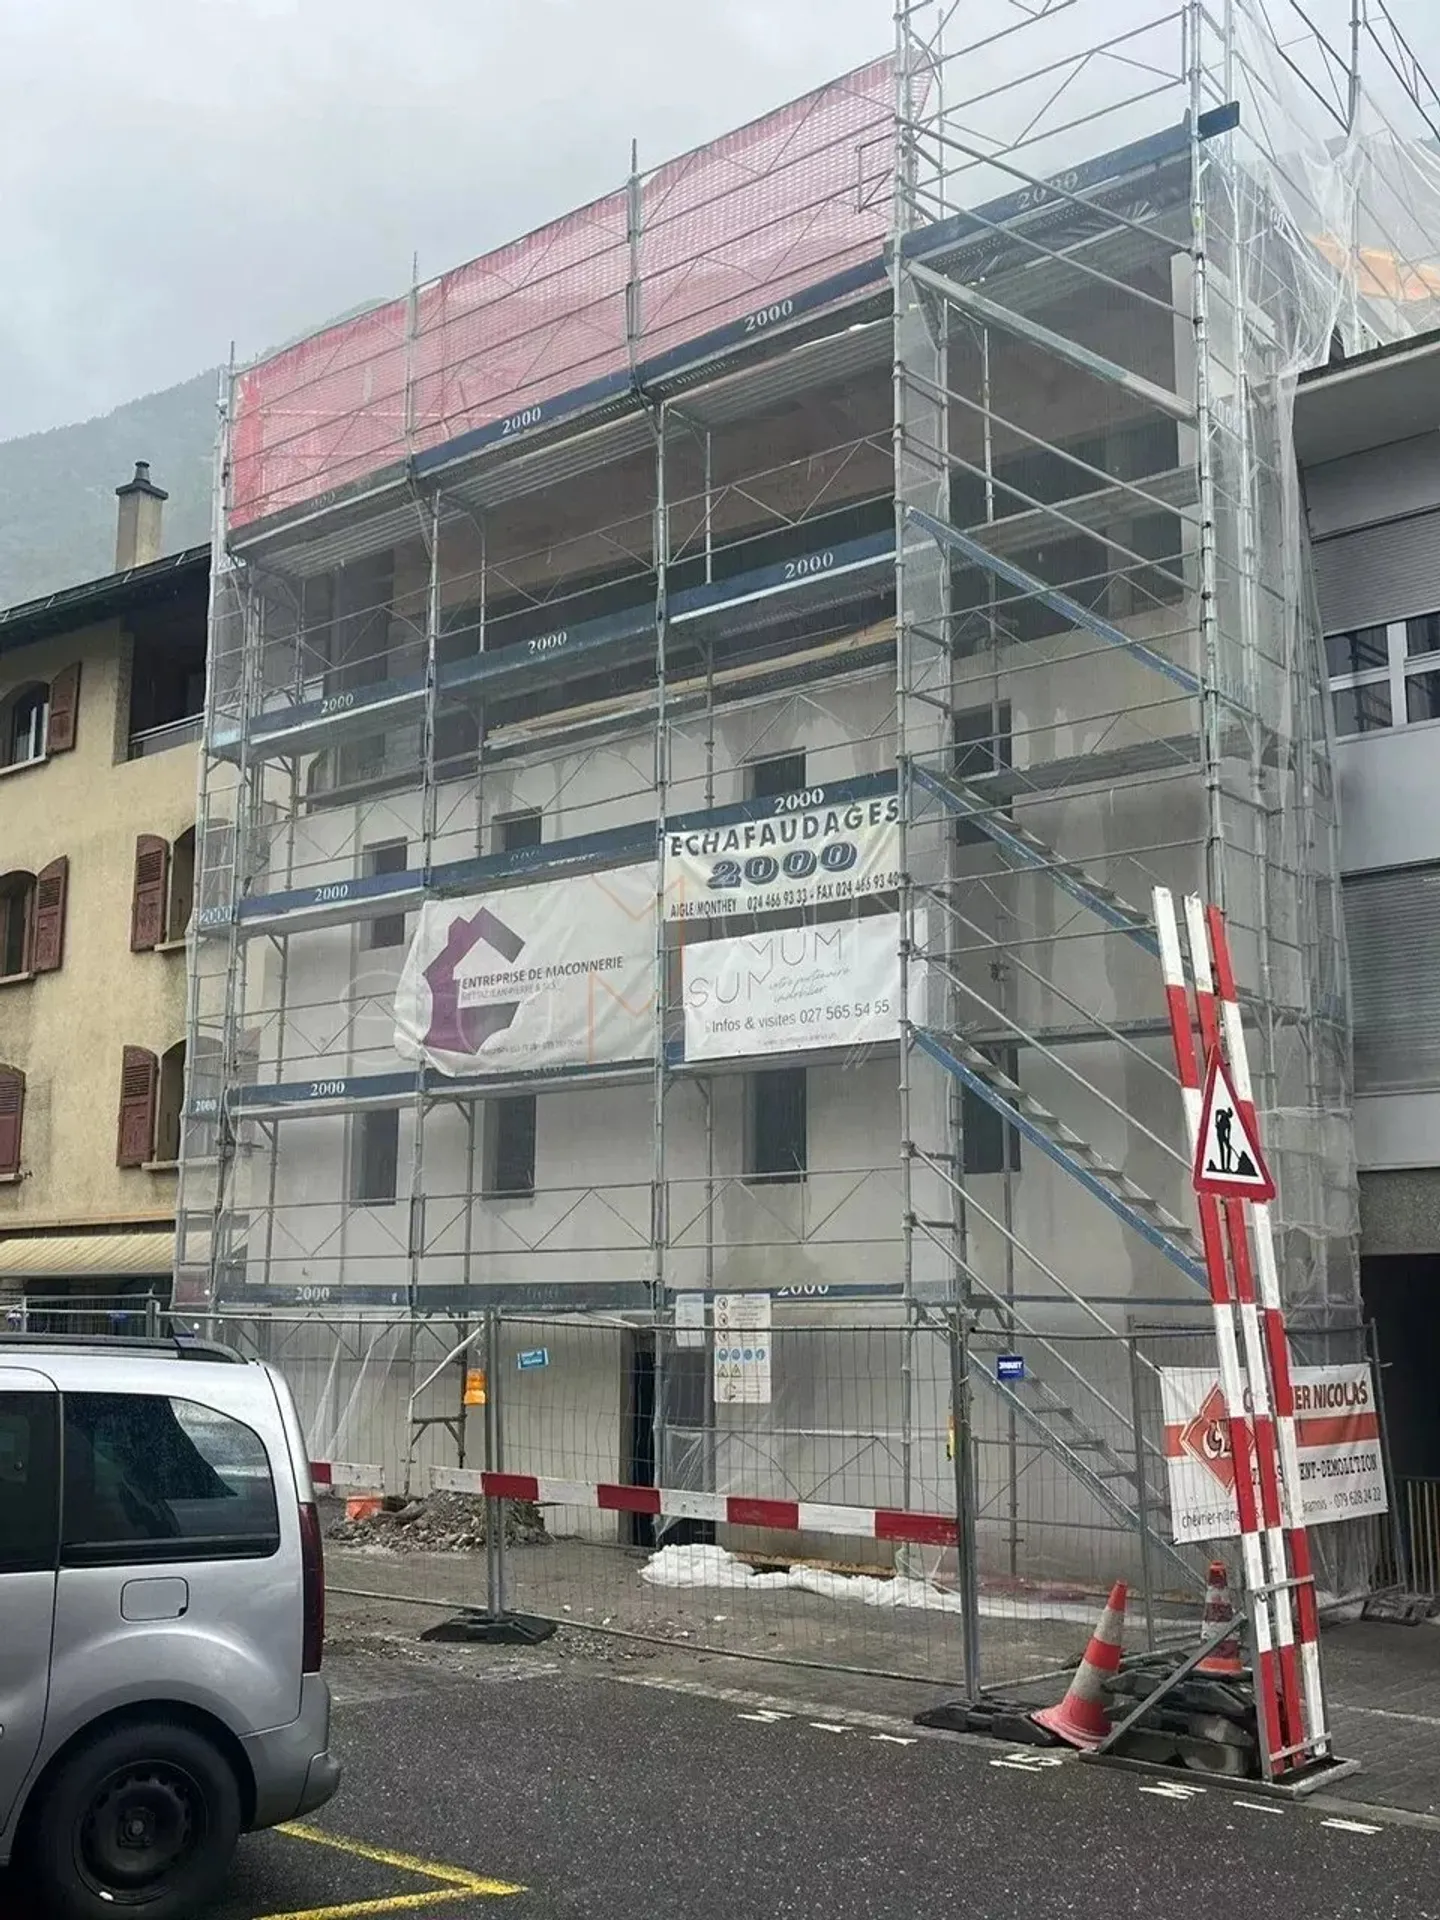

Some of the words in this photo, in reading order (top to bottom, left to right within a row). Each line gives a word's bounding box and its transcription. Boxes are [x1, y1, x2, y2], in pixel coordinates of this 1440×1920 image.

[743, 299, 795, 334] 2000
[501, 405, 543, 435] 2000
[784, 550, 835, 580] 2000
[527, 630, 568, 655] 2000
[320, 693, 354, 715] 2000
[773, 787, 825, 815] 2000
[670, 797, 899, 857] ECHAFAUDAGES
[707, 842, 858, 889] 2000
[314, 884, 348, 901] 2000
[670, 902, 694, 918] AIGLE
[697, 899, 737, 914] MONTHEY
[747, 895, 763, 911] 024
[784, 891, 795, 906] 93
[796, 888, 807, 904] 33
[816, 884, 833, 900] FAX
[835, 881, 851, 898] 024
[873, 873, 885, 889] 93
[200, 906, 232, 925] 2000
[462, 969, 525, 990] ENTREPRISE
[528, 967, 542, 981] DE
[545, 956, 624, 979] MACONNERIE
[712, 1018, 741, 1033] Infos
[744, 1018, 755, 1030] &
[759, 1013, 796, 1028] visites
[799, 1008, 822, 1025] 027
[826, 1005, 850, 1021] 565
[854, 1002, 870, 1018] 54
[873, 998, 890, 1016] 55
[310, 1081, 346, 1097] 2000
[195, 1100, 217, 1113] 2000
[295, 1286, 330, 1300] 2000
[1314, 1380, 1368, 1409] NICOLAS
[1334, 1492, 1349, 1508] 079
[989, 1753, 1063, 1772] 15
